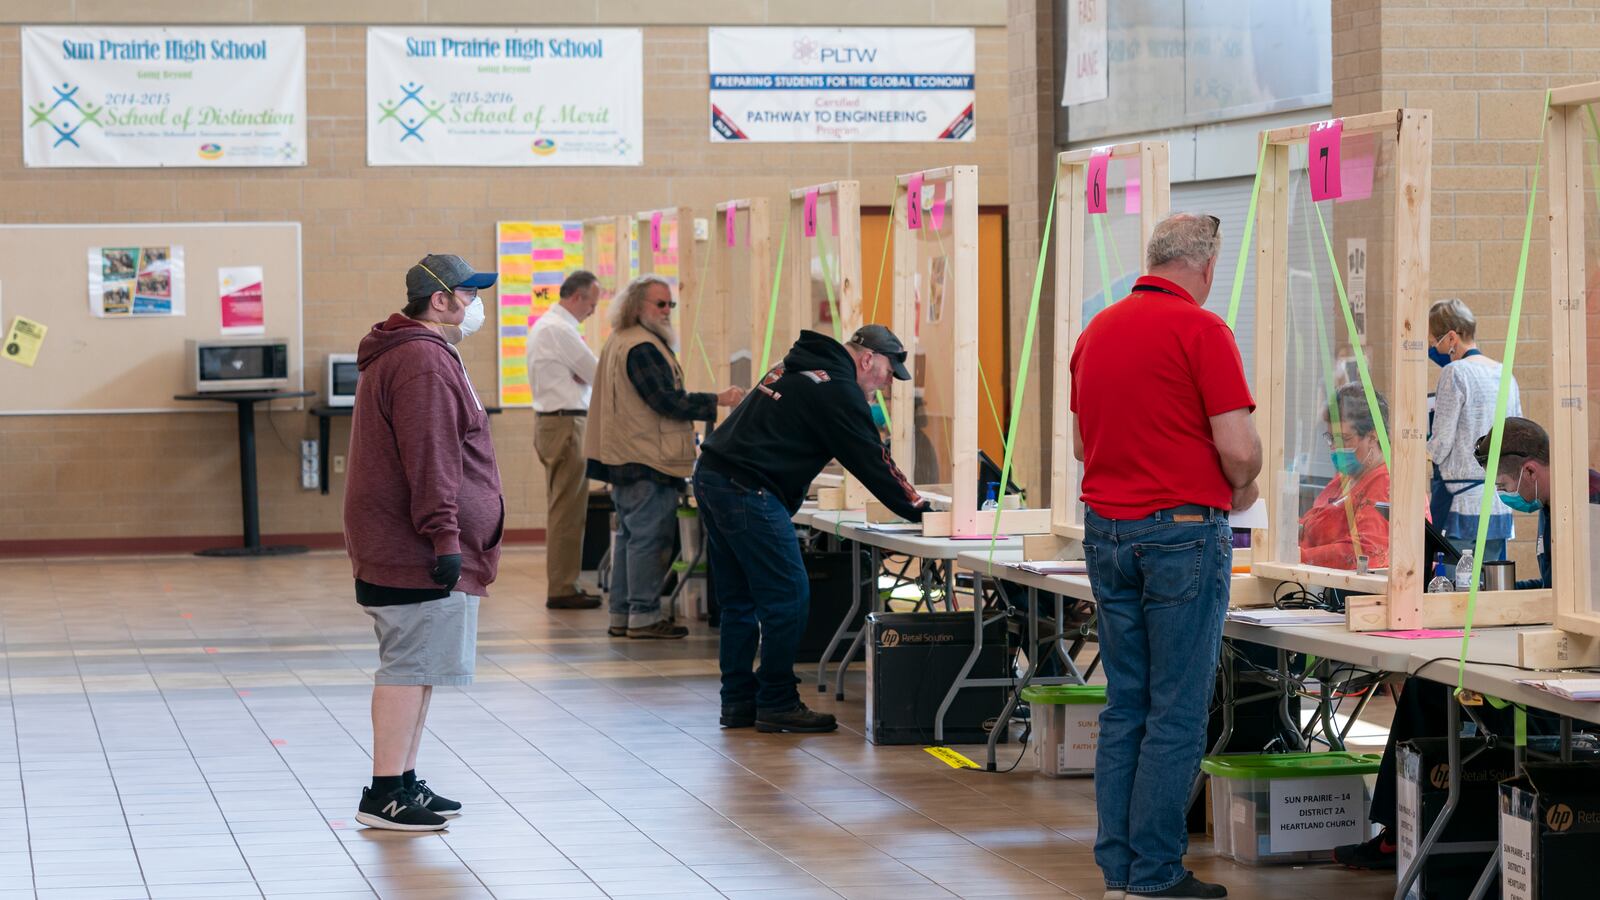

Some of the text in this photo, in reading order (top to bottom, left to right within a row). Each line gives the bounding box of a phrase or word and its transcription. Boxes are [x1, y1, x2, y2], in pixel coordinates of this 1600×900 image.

[62, 39, 267, 63] Sun Prairie High School
[406, 37, 603, 60] Sun Prairie High School
[820, 48, 877, 63] PLTW
[715, 76, 970, 87] PREPARING STUDENTS FOR THE GLOBAL ECONOMY
[105, 92, 171, 105] 2014-2015
[450, 91, 513, 104] 2015-2016
[815, 97, 860, 108] Certified
[105, 105, 295, 131] School of Distinction
[449, 103, 609, 129] School of Merit
[747, 111, 810, 123] PATHWAY
[814, 111, 832, 123] TO
[834, 111, 927, 124] ENGINEERING
[816, 125, 860, 138] Program
[1320, 146, 1330, 194] 7
[1094, 167, 1101, 208] 6
[882, 629, 953, 647] hp Retail Solution
[415, 793, 433, 807] N
[1284, 796, 1302, 804] SUN
[1303, 795, 1333, 803] PRAIRIE
[1341, 793, 1350, 801] 14
[381, 800, 407, 818] N
[1299, 807, 1345, 817] DISTRICT 2A
[1548, 803, 1600, 831] hp Reta
[1280, 820, 1355, 831] HEARTLAND CHURCH
